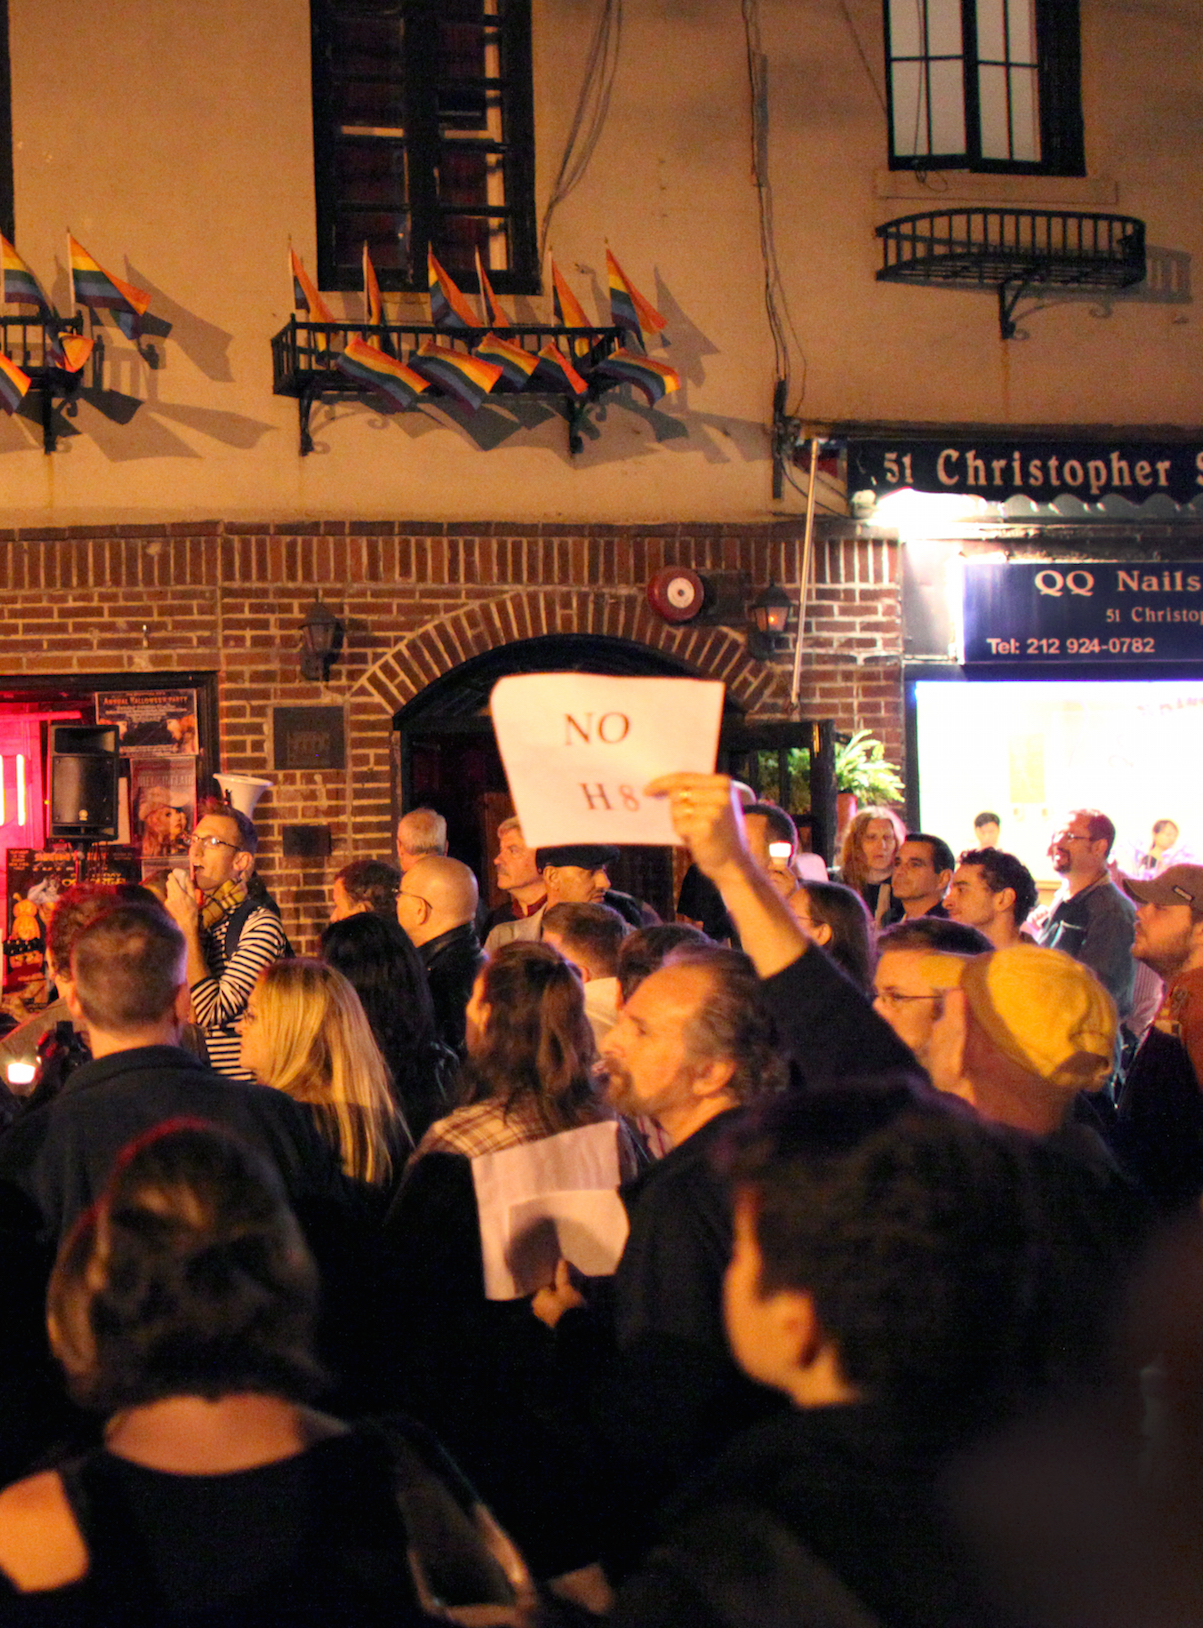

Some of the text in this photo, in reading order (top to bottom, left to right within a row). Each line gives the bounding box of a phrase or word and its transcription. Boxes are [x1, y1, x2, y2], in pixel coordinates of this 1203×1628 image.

[884, 452, 914, 484] 51
[937, 448, 1171, 495] Christopher
[1034, 570, 1202, 597] QQ Nails
[1106, 606, 1203, 626] 51 Christo
[986, 637, 1156, 654] Tel: 212 924-0782
[564, 711, 630, 746] NO
[579, 782, 640, 812] H8
